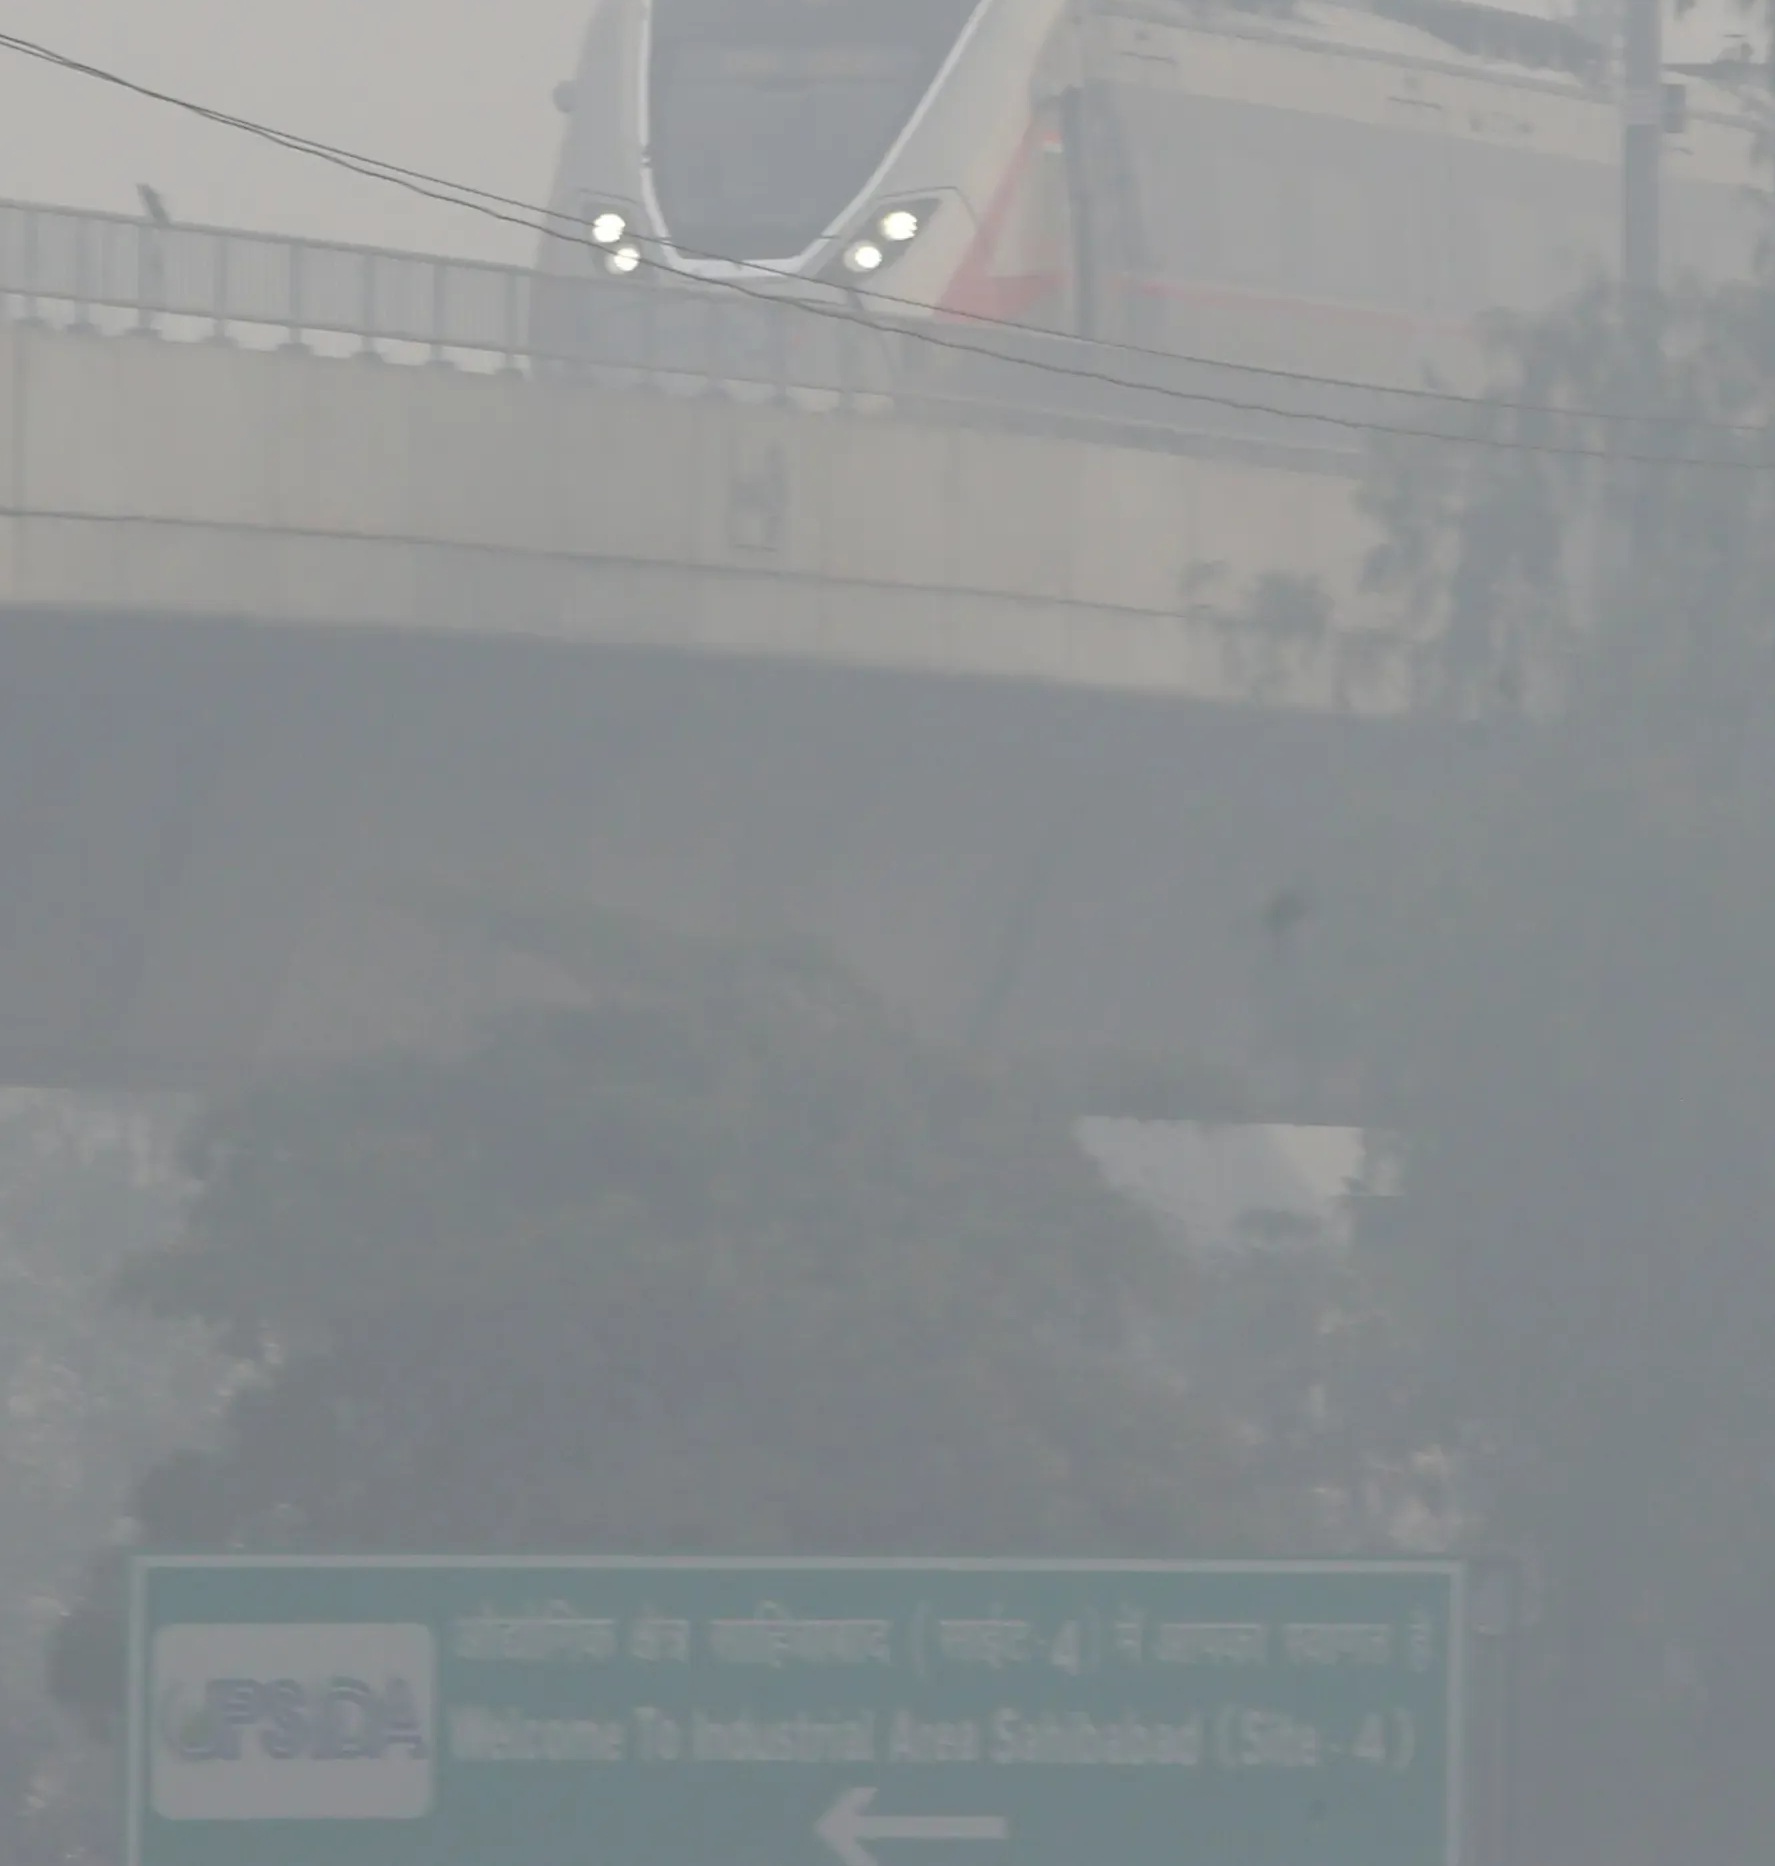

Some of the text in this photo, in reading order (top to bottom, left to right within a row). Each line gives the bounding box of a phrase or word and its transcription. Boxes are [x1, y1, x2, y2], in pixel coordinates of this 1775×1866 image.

[448, 1703, 626, 1761] Welcome
[633, 1705, 681, 1762] To
[691, 1704, 876, 1762] Industrial
[888, 1704, 977, 1762] Area
